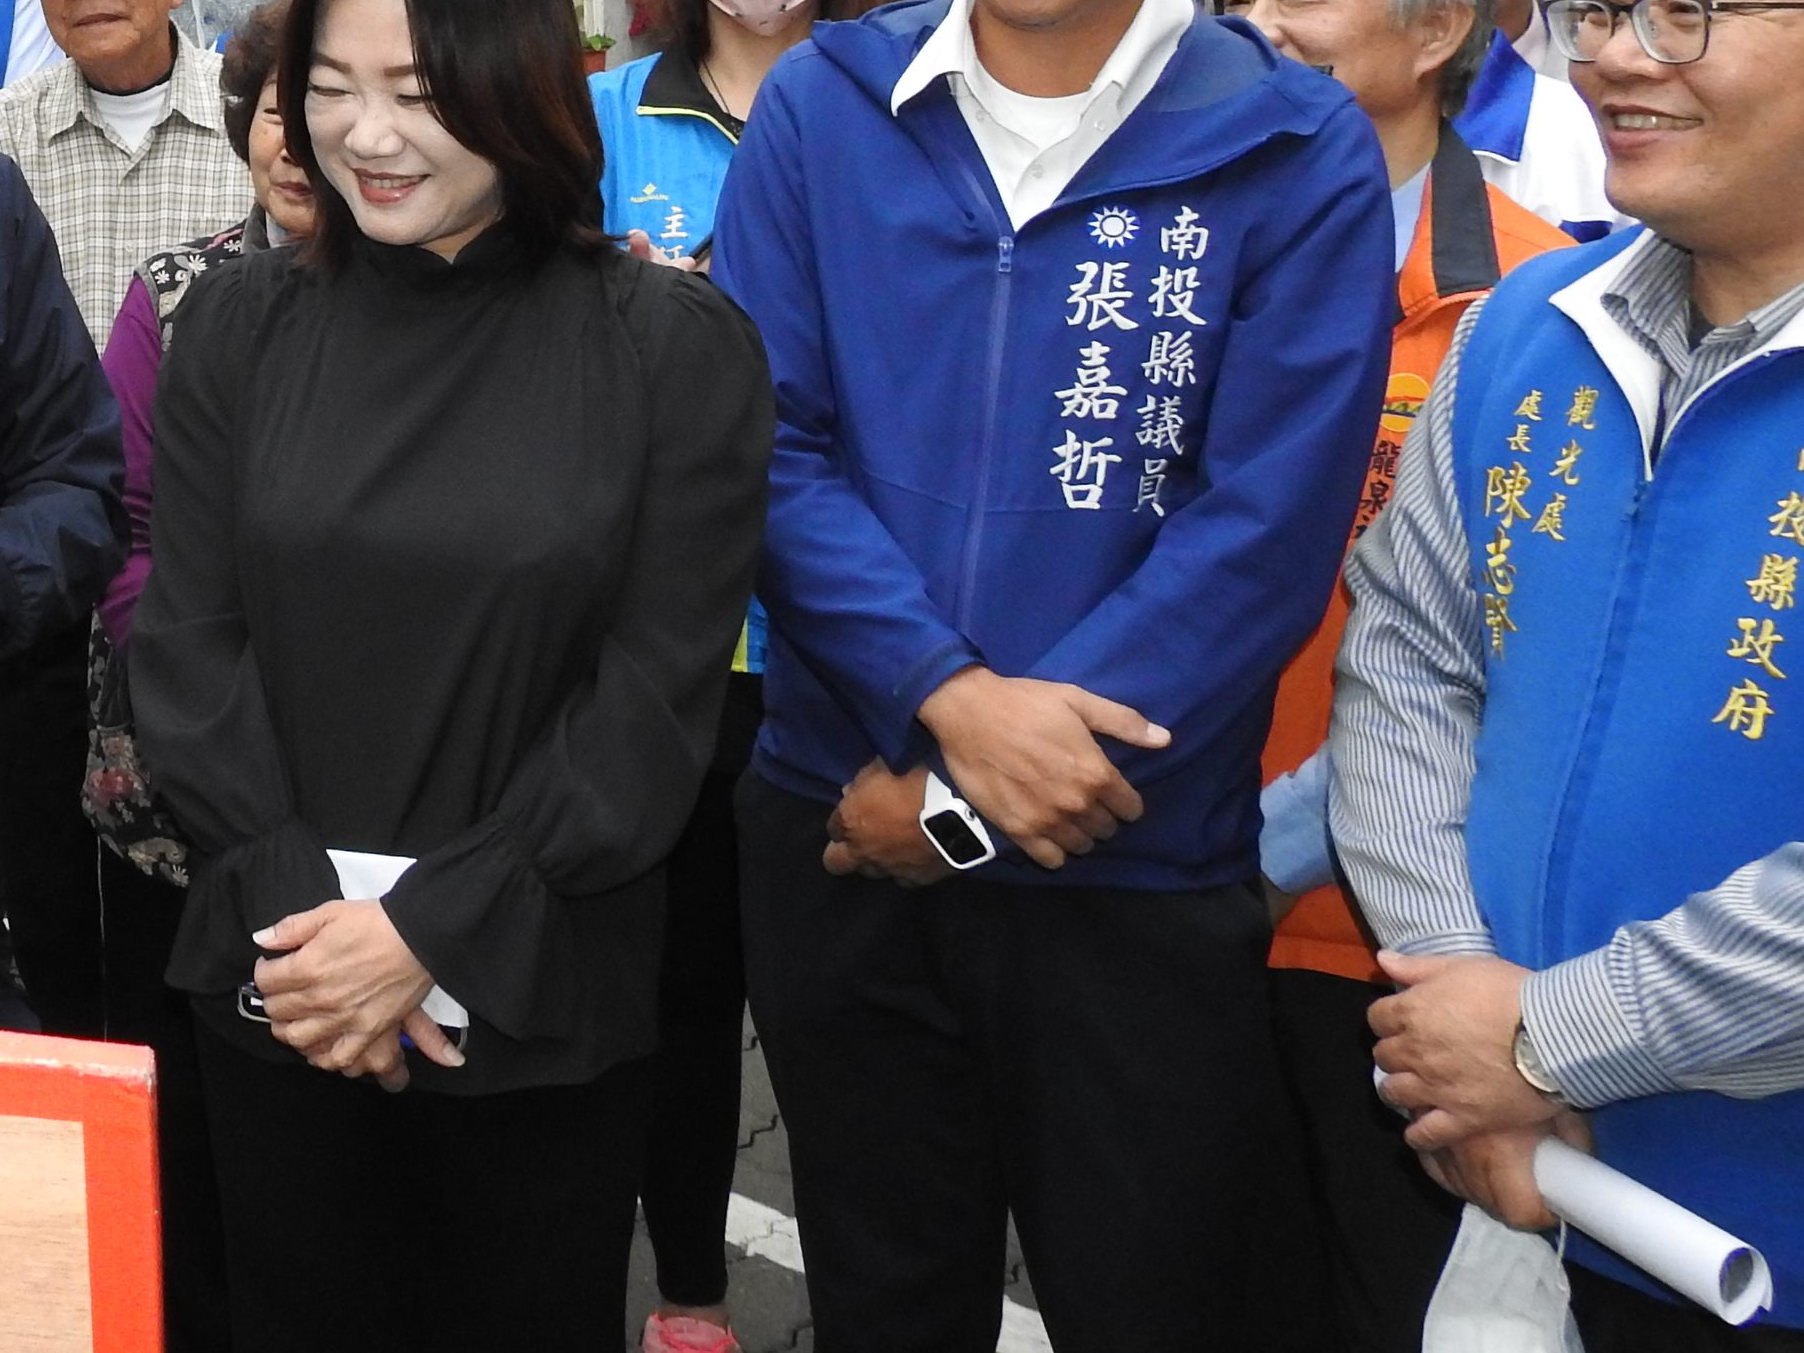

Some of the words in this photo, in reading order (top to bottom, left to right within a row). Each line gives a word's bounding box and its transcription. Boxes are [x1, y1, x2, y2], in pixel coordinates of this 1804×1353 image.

[1049, 261, 1140, 510] 張嘉哲
[1132, 205, 1209, 518] 南投縣議員
[1532, 385, 1600, 542] 觀光處
[1353, 439, 1402, 540] 龍泉
[1710, 446, 1804, 741] 投縣政府
